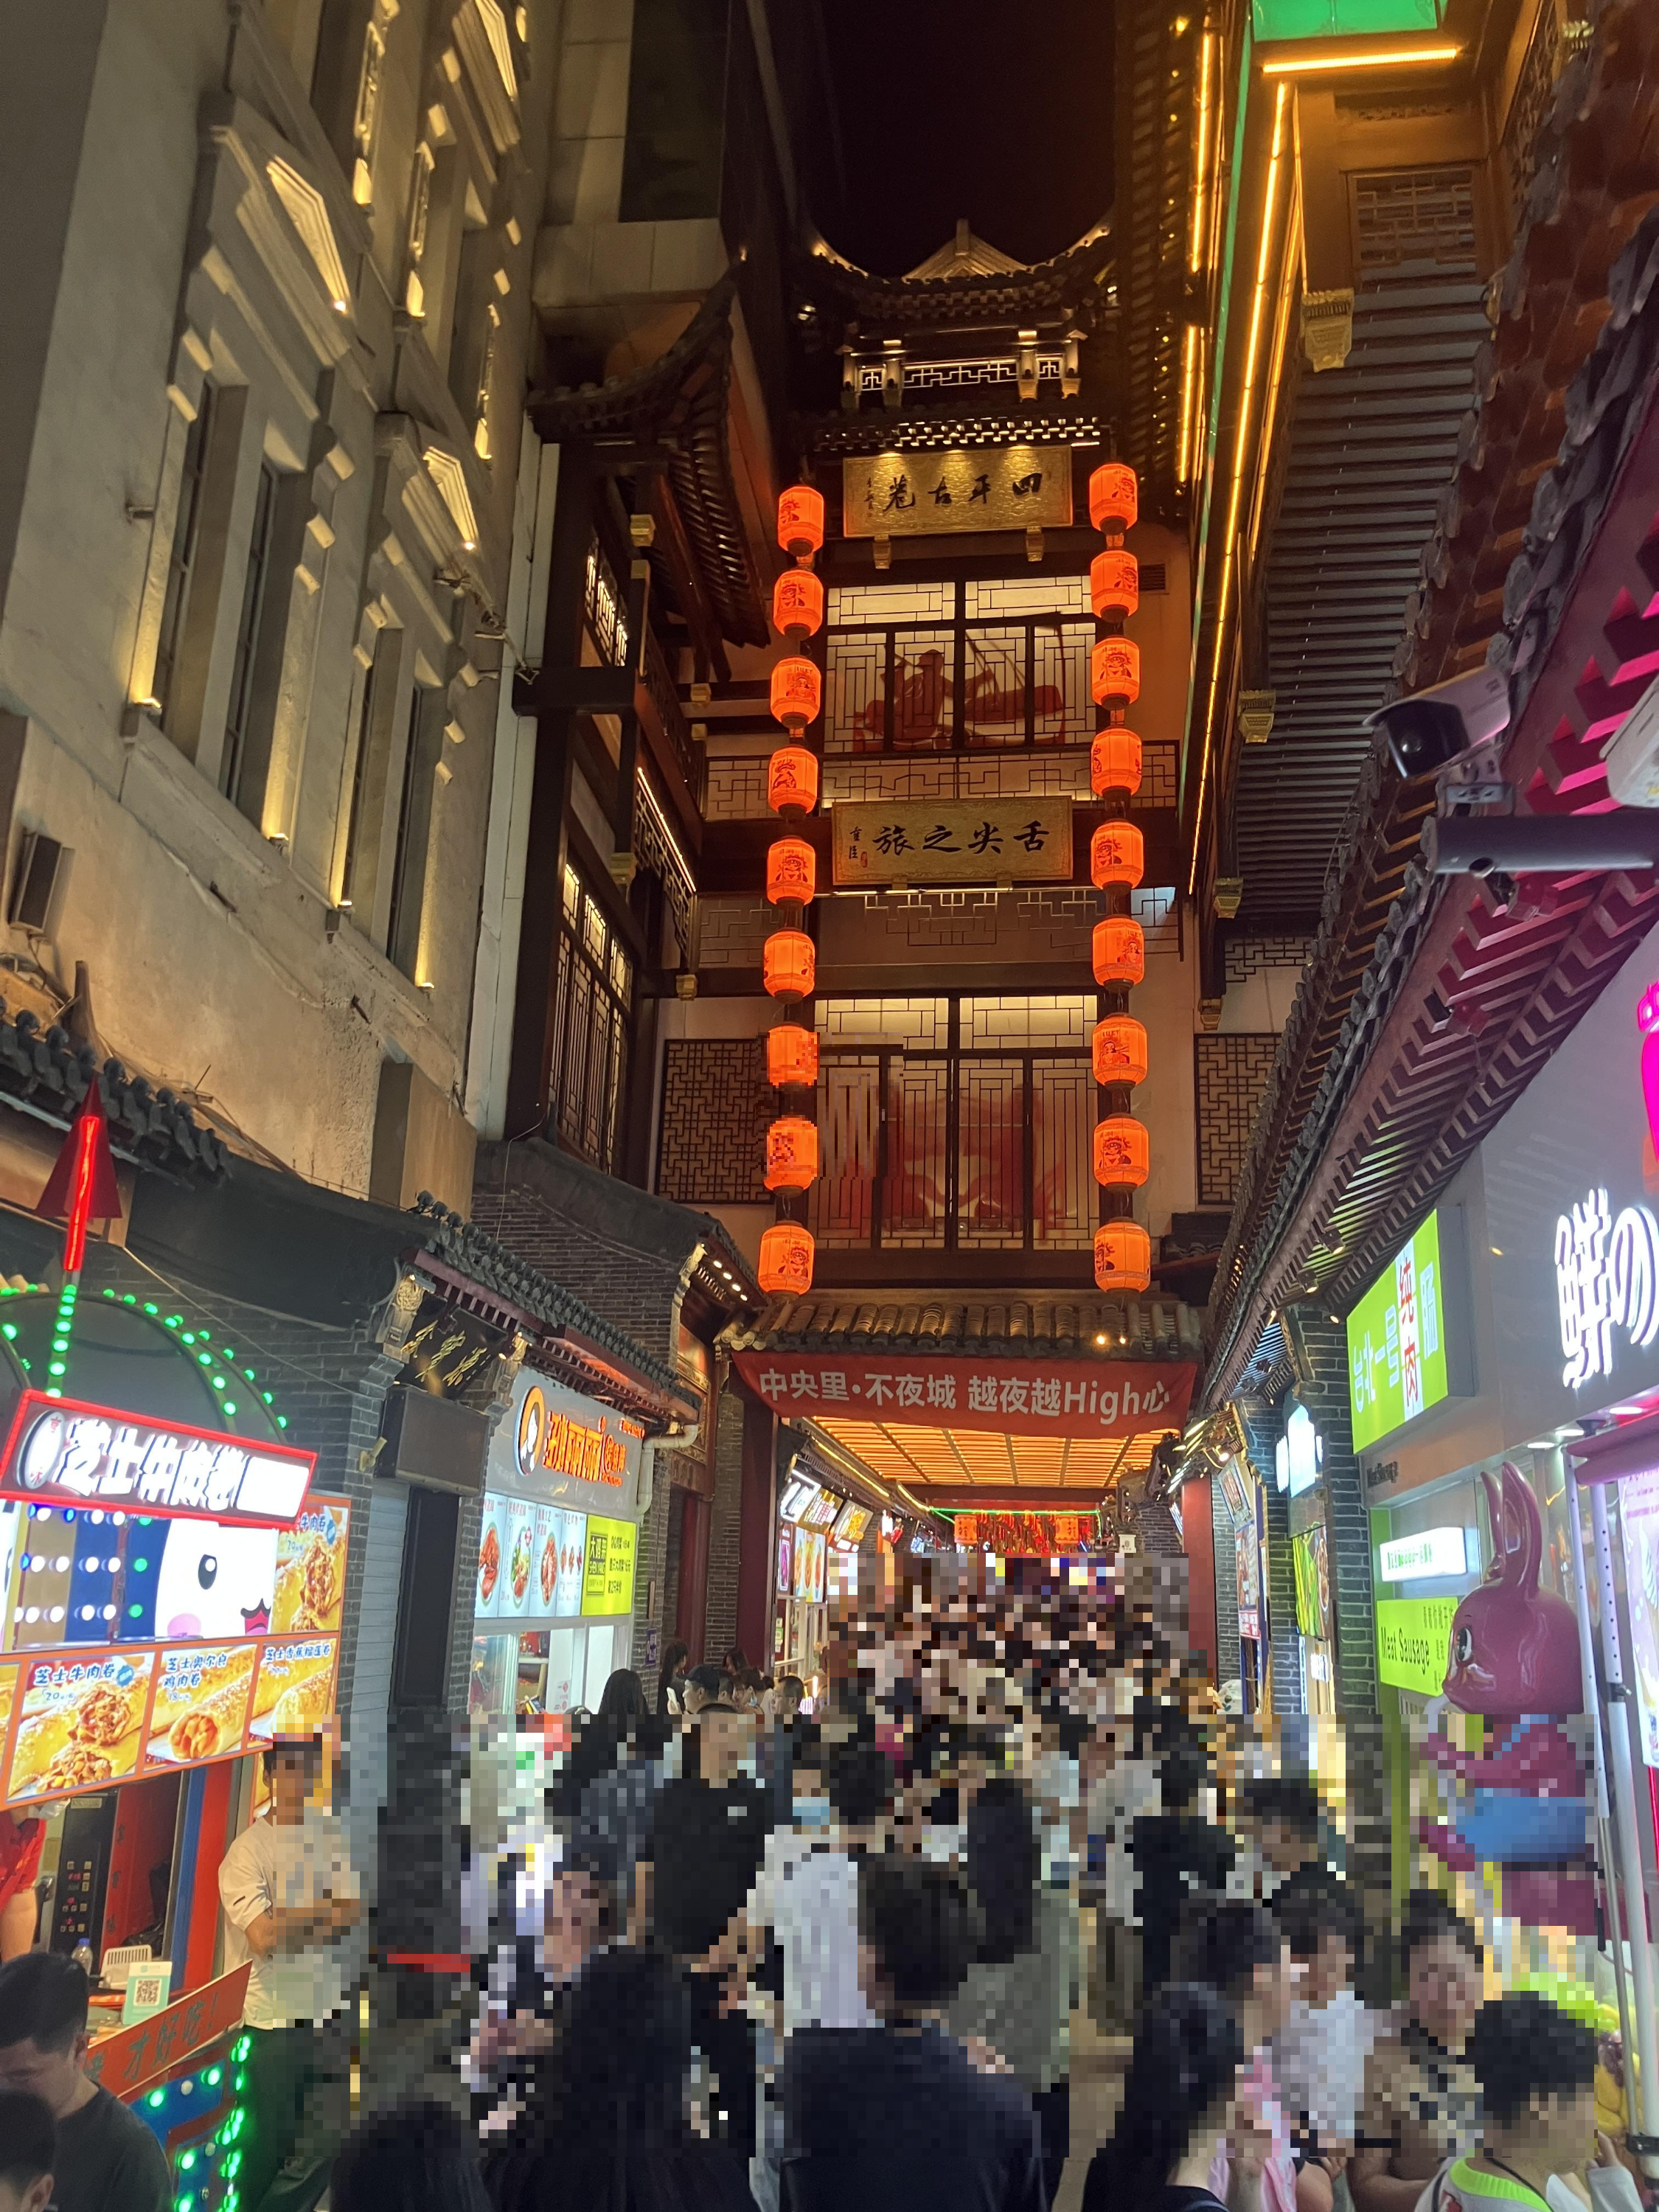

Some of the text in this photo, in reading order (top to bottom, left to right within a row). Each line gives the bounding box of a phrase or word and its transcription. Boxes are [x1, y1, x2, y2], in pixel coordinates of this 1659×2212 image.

[872, 820, 1050, 856] 舌尖之旅
[1381, 1627, 1397, 1661] Meat
[1399, 1627, 1430, 1675] Sausage
[35, 1663, 115, 1684] 芝士牛肉卷
[164, 1673, 201, 1688] 鸡肉卷
